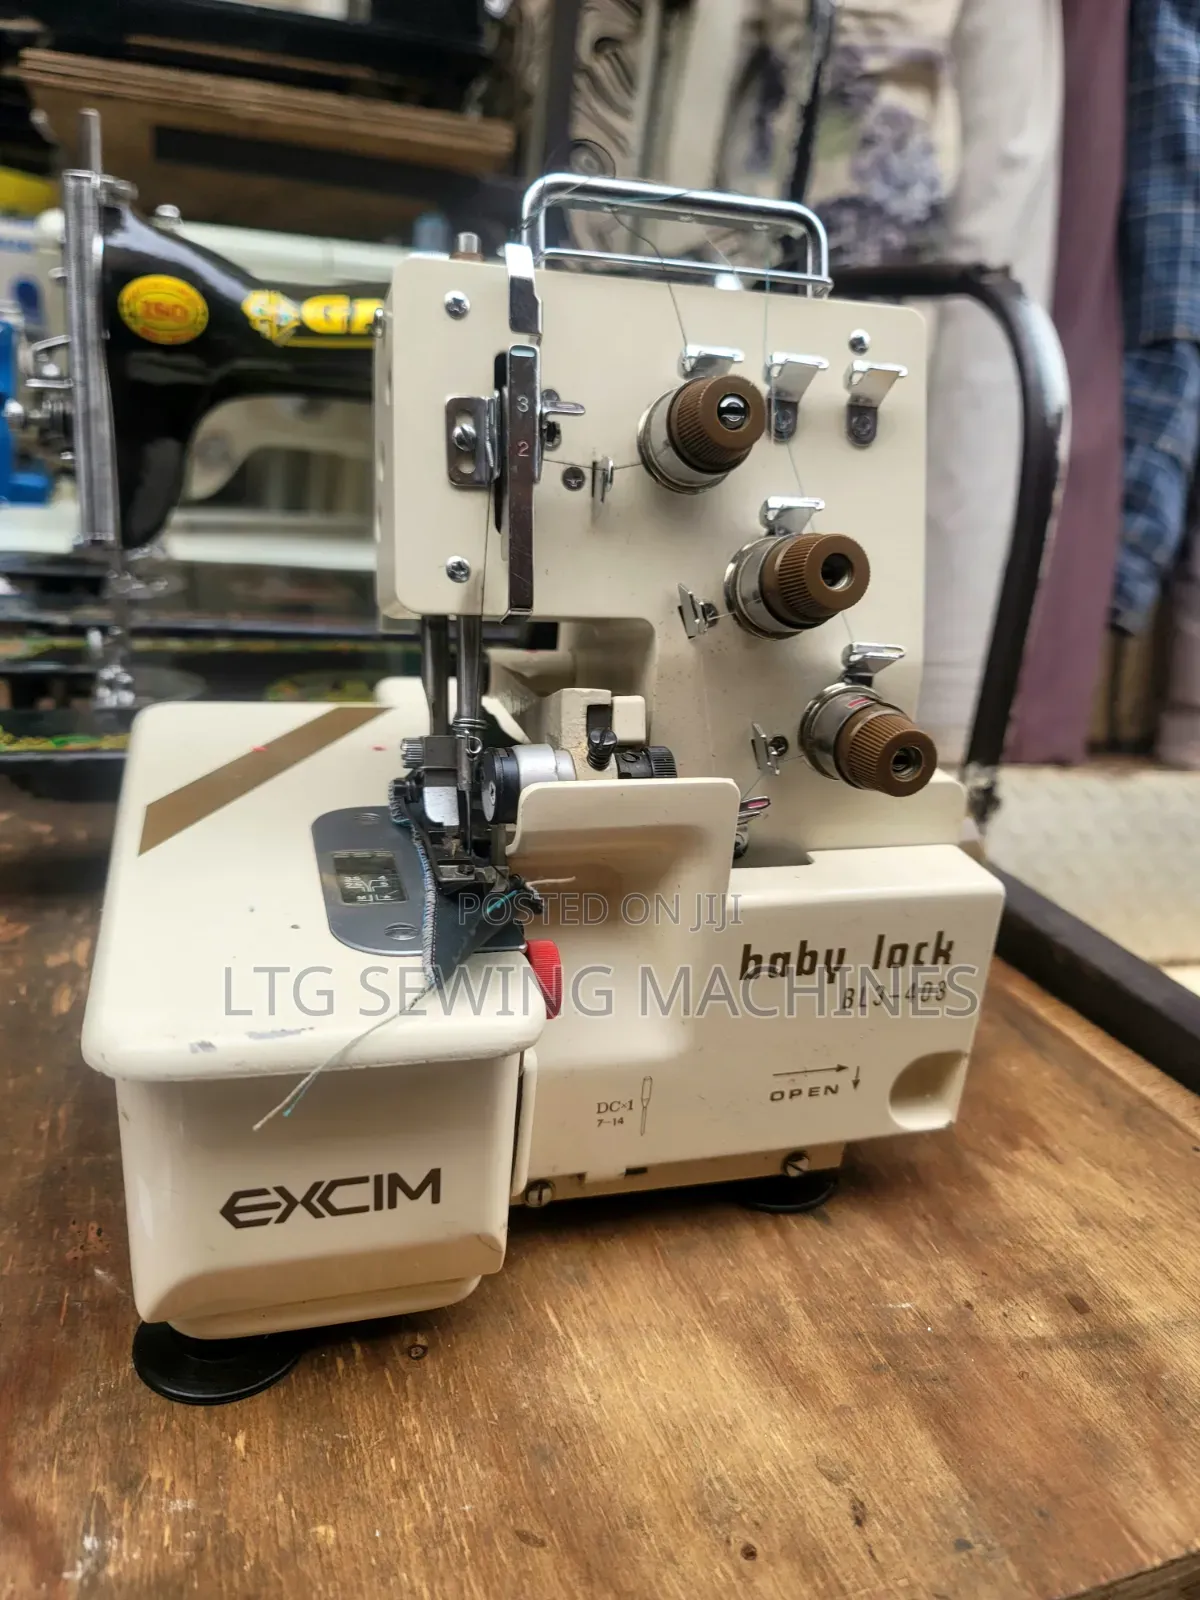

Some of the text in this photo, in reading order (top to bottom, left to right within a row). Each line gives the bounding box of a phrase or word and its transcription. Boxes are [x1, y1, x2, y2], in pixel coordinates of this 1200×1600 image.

[517, 396, 529, 413] 3
[517, 441, 529, 457] 2
[739, 930, 955, 984] baby lock
[842, 980, 947, 1010] BL3-403
[769, 1084, 840, 1102] OPEN
[219, 1167, 442, 1229] EXCIM
